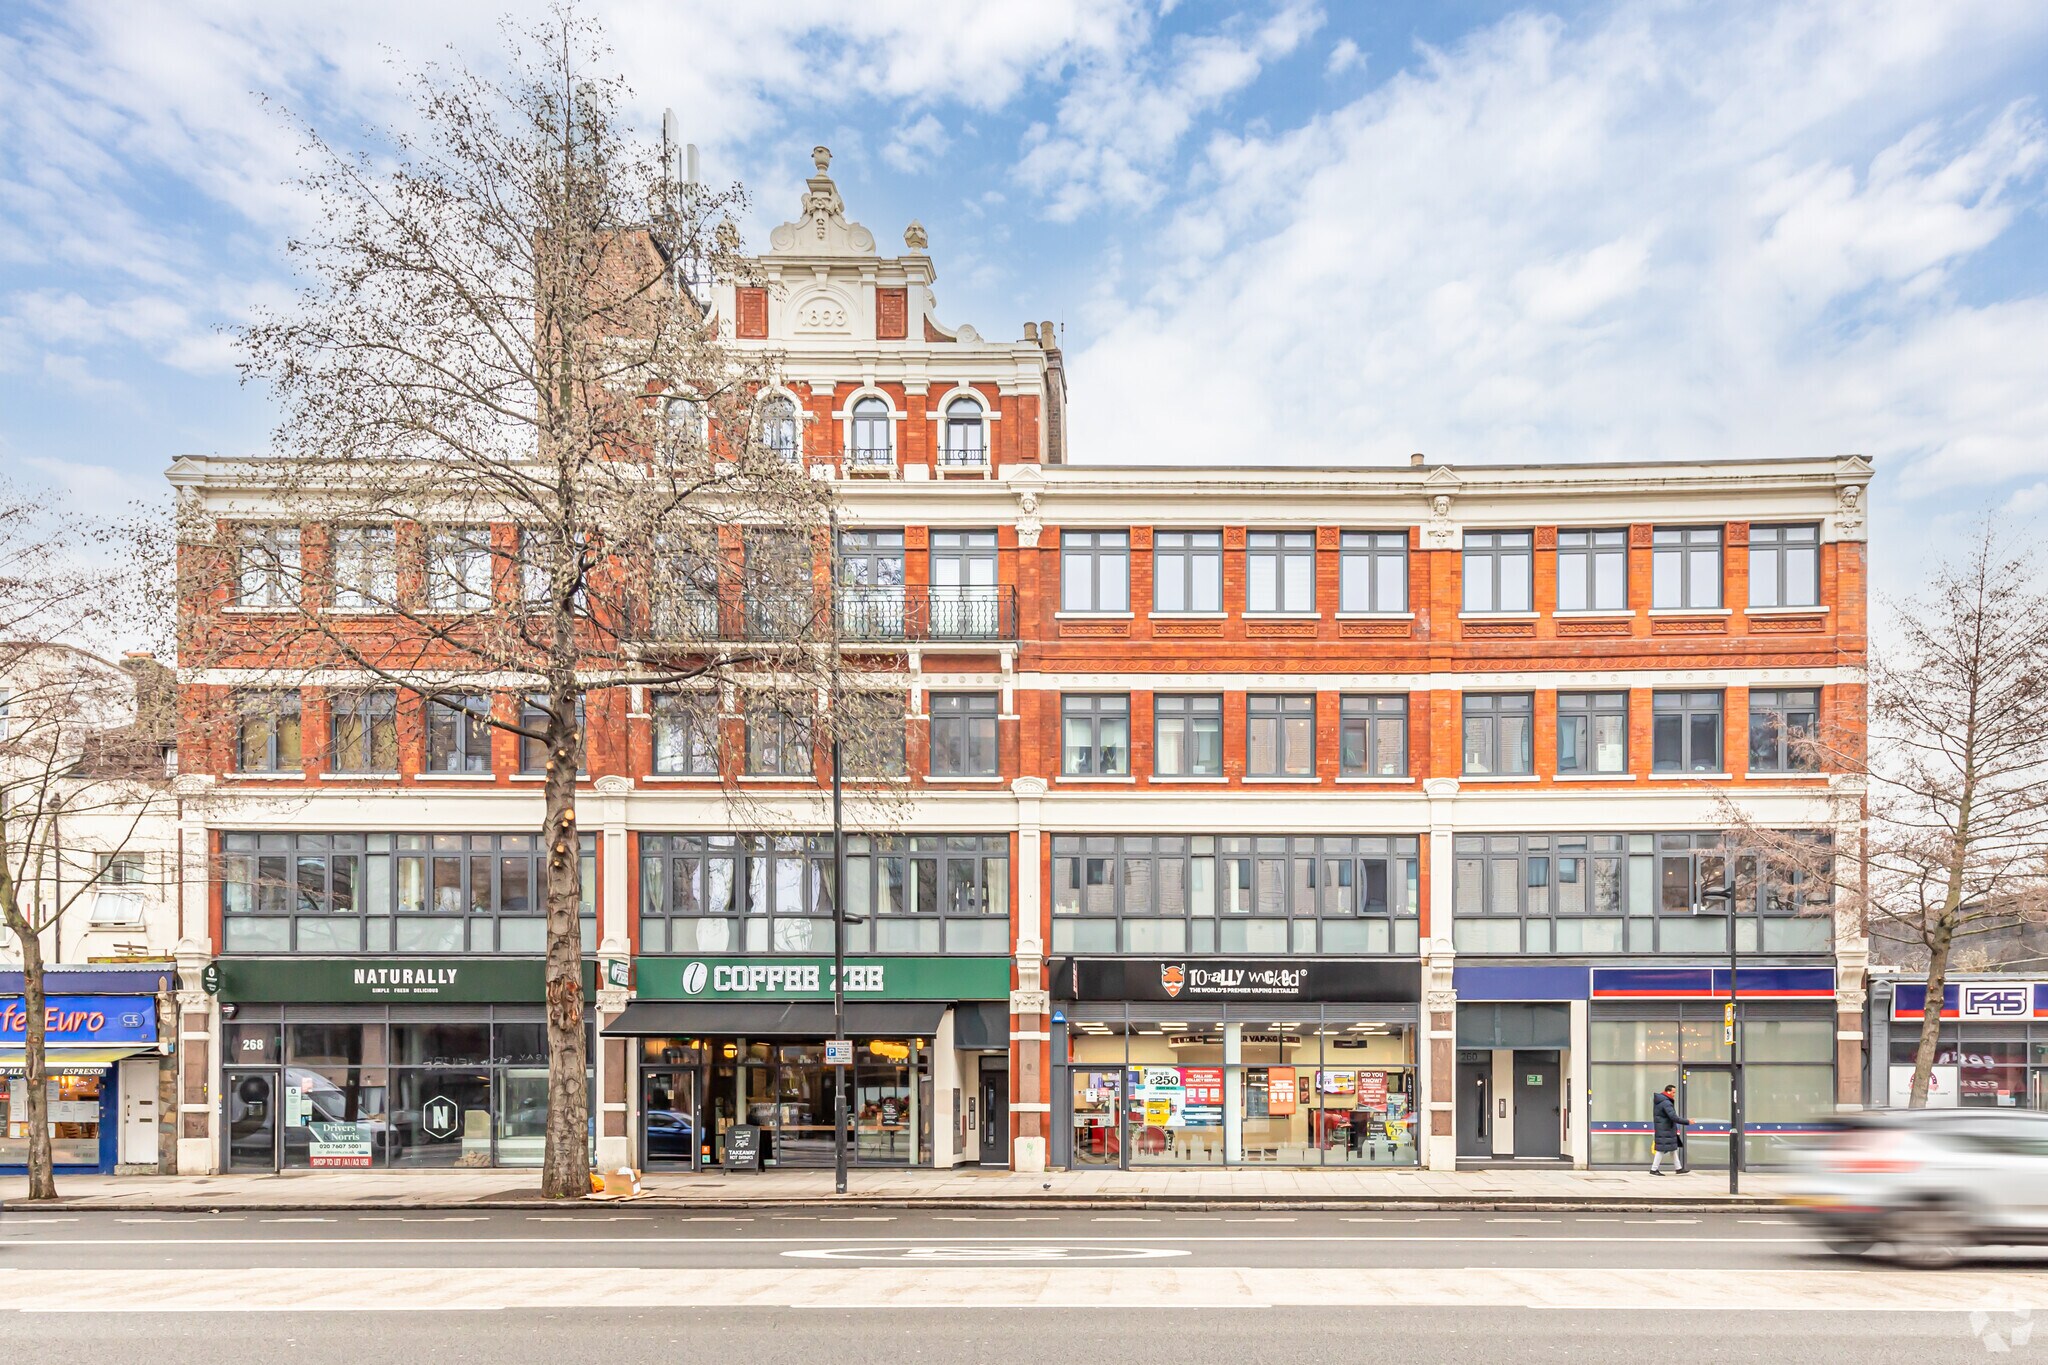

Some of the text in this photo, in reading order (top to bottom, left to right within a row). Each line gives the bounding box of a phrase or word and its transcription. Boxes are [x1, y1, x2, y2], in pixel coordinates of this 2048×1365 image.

[800, 310, 846, 327] 1893
[354, 968, 458, 985] NATURALLY
[1966, 988, 2026, 1015] F45
[0, 1004, 105, 1032] fe Euro
[242, 1039, 264, 1051] 268
[1461, 1052, 1478, 1061] 260
[1150, 1075, 1179, 1086] £250
[433, 1106, 449, 1129] N
[323, 1123, 356, 1132] Drivers
[331, 1132, 360, 1141] Norris
[313, 1158, 326, 1166] SHOP
[327, 1158, 333, 1166] TO
